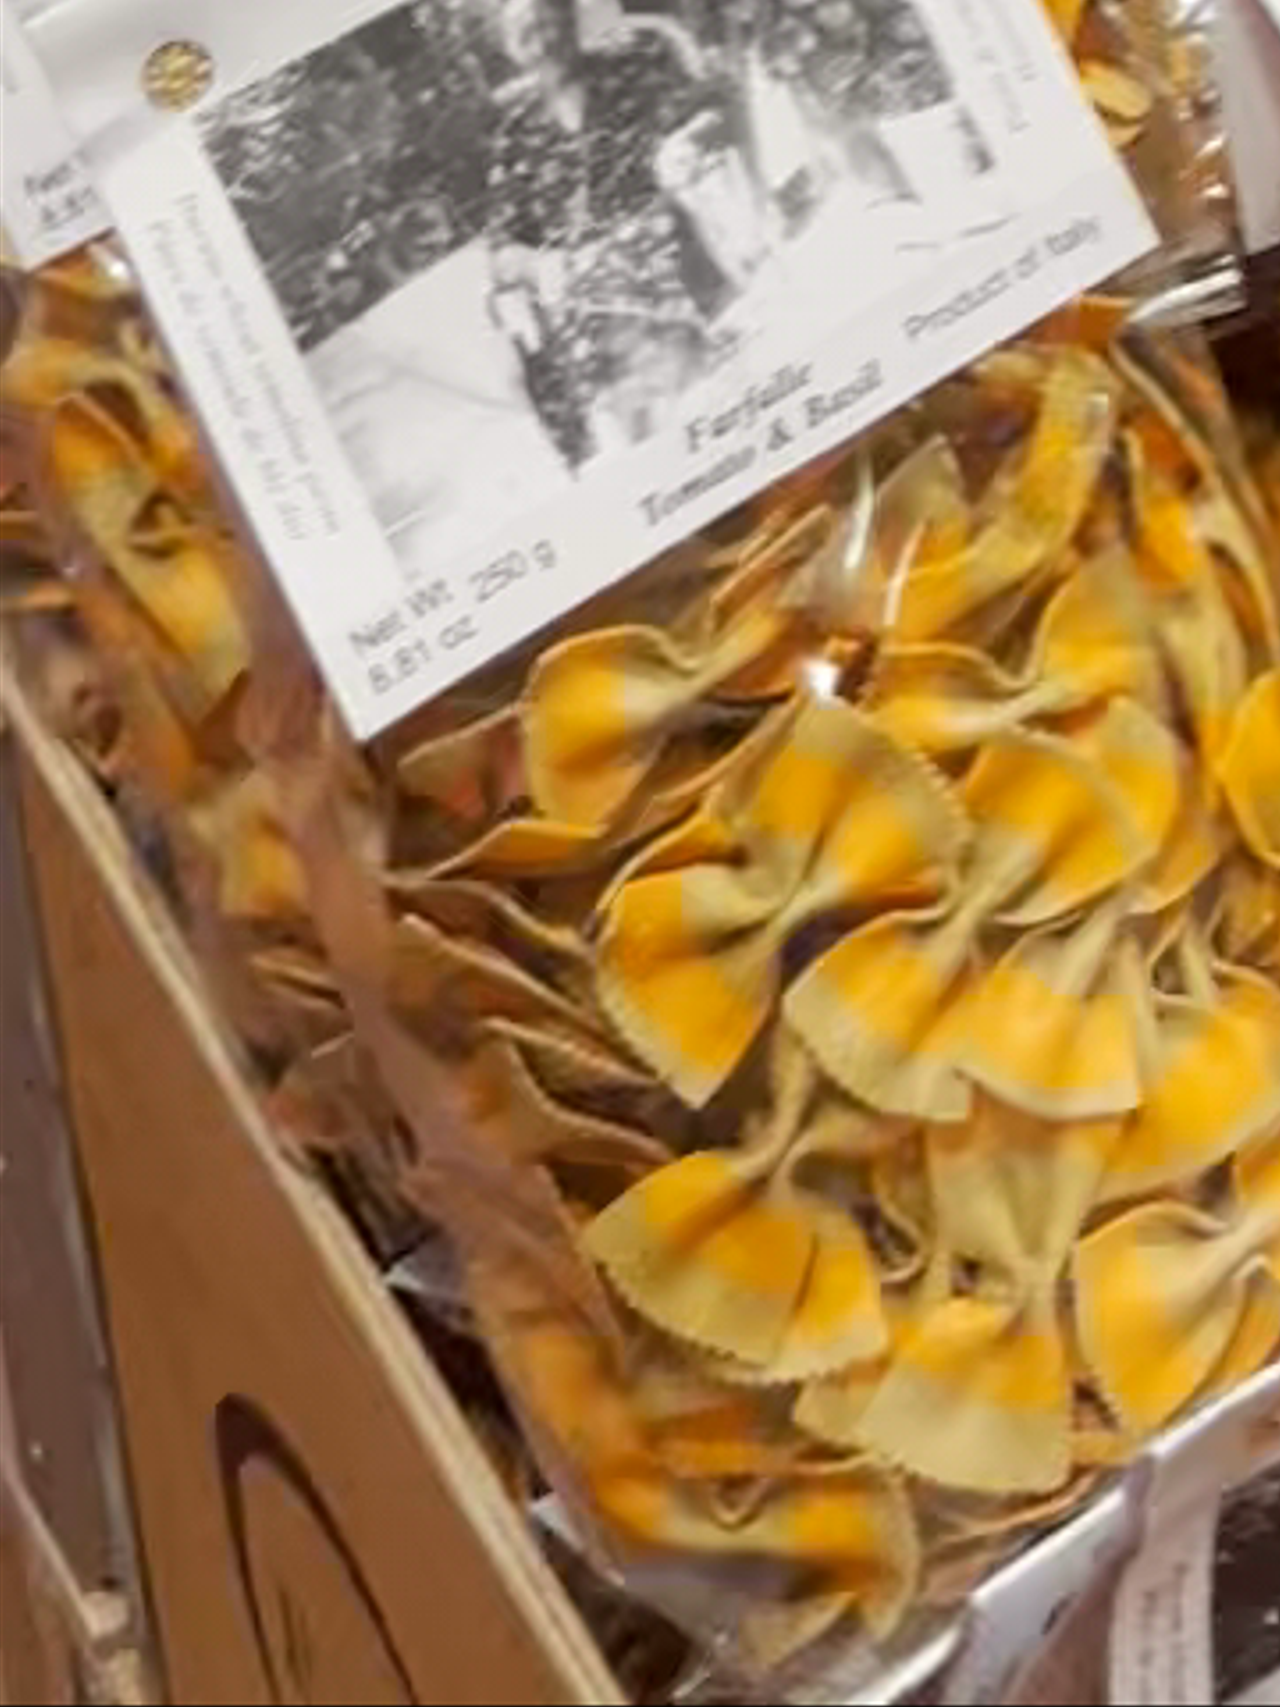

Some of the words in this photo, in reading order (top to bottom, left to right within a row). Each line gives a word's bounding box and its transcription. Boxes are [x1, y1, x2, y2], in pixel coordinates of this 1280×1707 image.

[904, 268, 1010, 339] Product
[1015, 243, 1042, 278] of
[1045, 213, 1103, 260] Italy
[638, 444, 757, 527] Tomato
[767, 418, 794, 454] &
[804, 358, 884, 430] Basil
[685, 361, 815, 454] Farfalle
[348, 608, 407, 657] Net
[467, 548, 528, 604] 250
[531, 538, 557, 573] g
[367, 637, 432, 695] 8.81
[437, 614, 482, 652] oz
